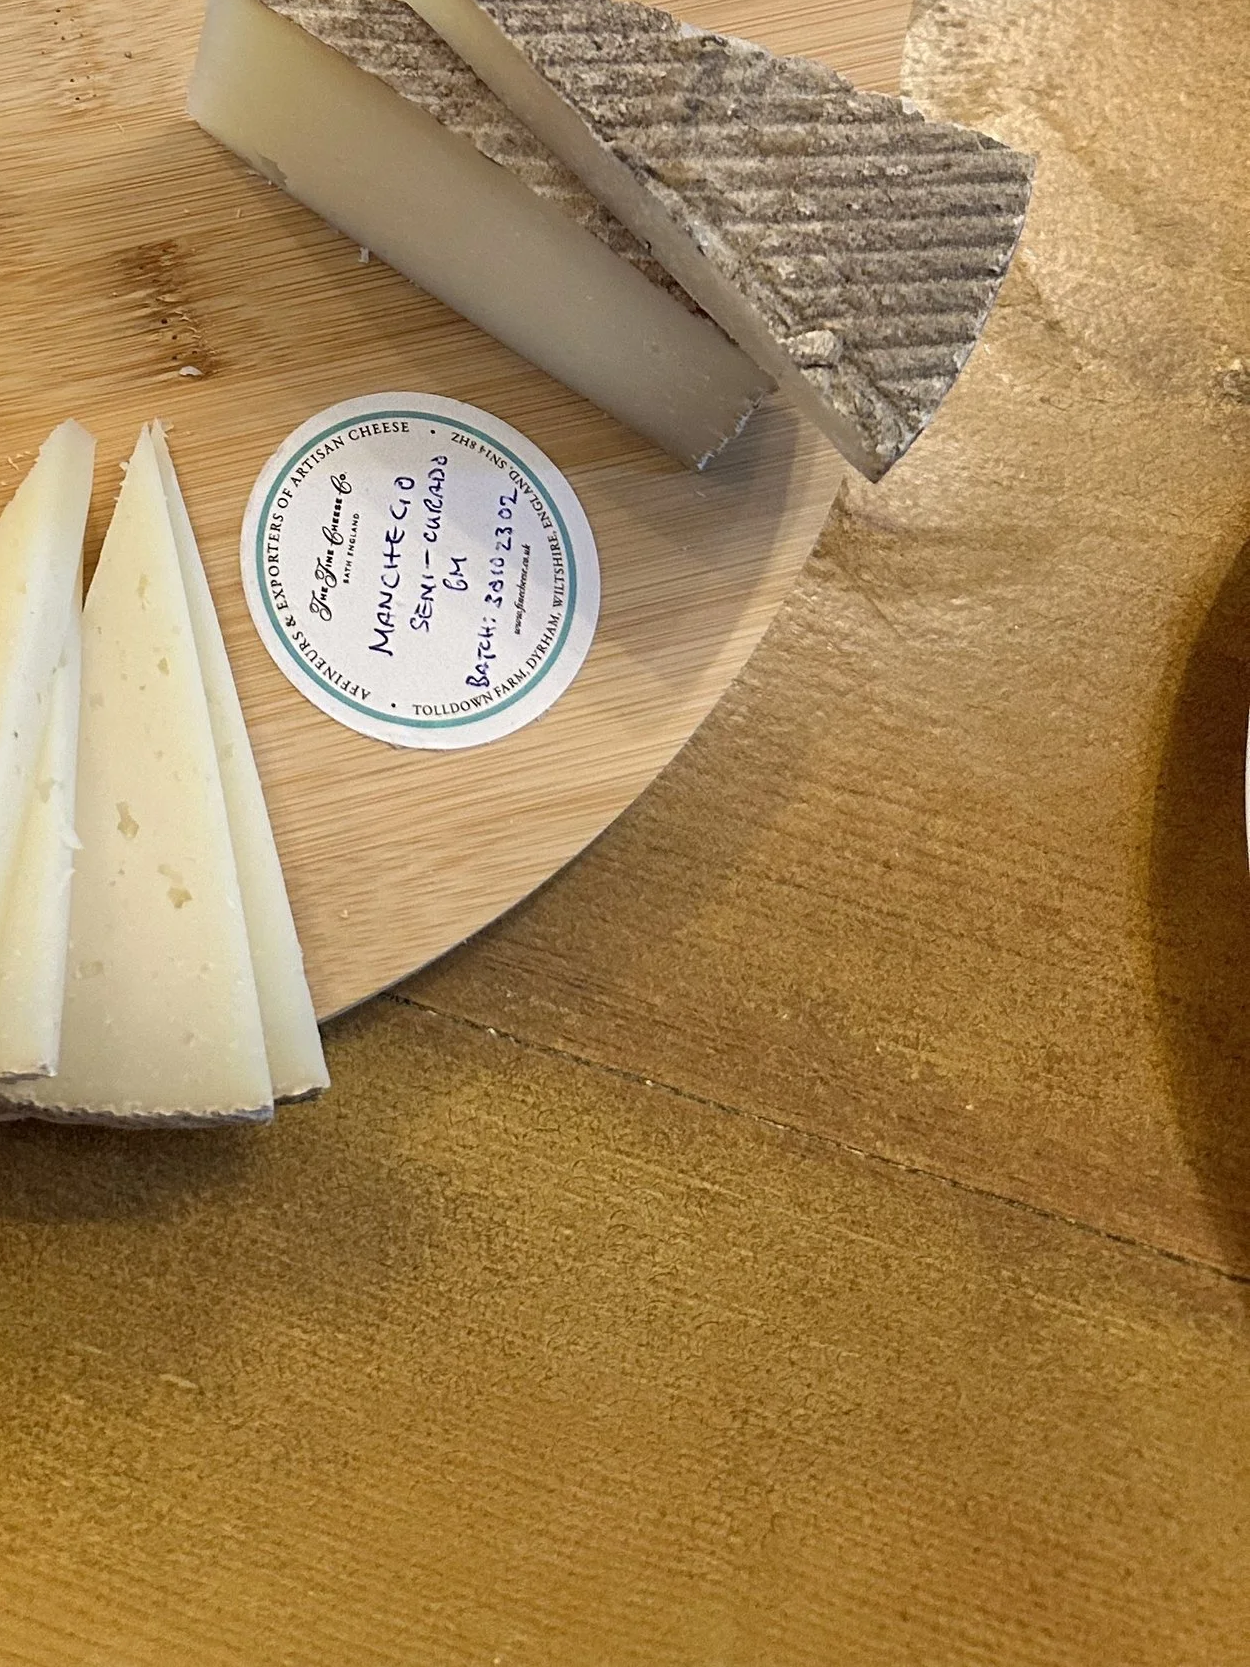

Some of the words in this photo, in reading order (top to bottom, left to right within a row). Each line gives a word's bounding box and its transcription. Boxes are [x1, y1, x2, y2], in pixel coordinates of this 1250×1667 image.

[347, 420, 410, 442] CHEESE
[451, 431, 478, 450] 8HZ
[478, 444, 508, 471] SN14
[290, 435, 346, 489] ARTISAN
[278, 486, 294, 510] OF
[267, 516, 289, 613] EXPORTERS
[342, 559, 351, 584] BATH
[348, 512, 361, 559] ENGLAND
[369, 475, 416, 657] MANCHEGO
[546, 530, 566, 609] WILTSHIRE,
[513, 544, 532, 635] www.finecheese.co.uk
[286, 616, 298, 628] &
[526, 607, 562, 670] DYRHAM,
[292, 630, 371, 701] AFFINEURS
[493, 668, 530, 698] FARM,
[412, 689, 493, 717] TOLLDOWN
